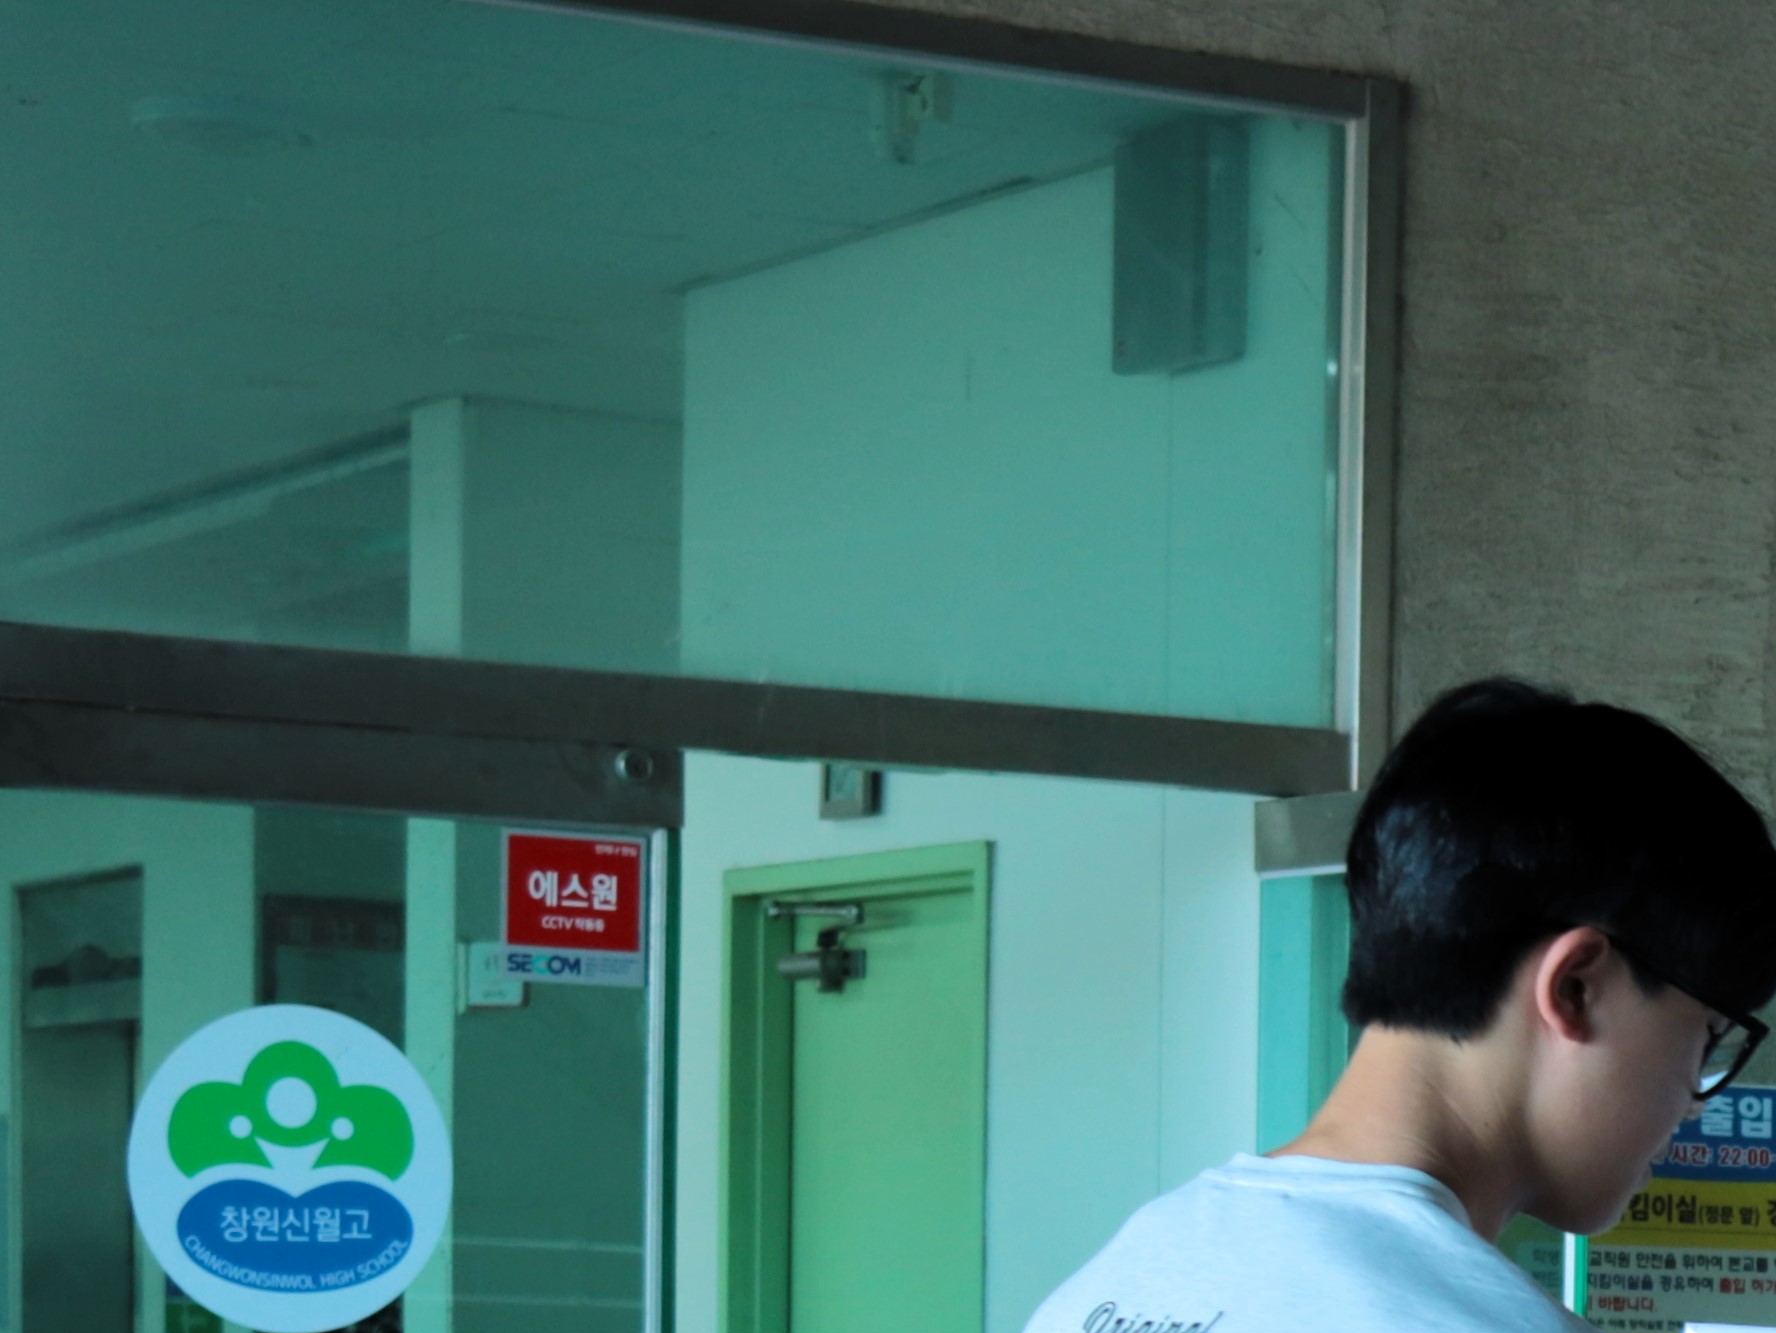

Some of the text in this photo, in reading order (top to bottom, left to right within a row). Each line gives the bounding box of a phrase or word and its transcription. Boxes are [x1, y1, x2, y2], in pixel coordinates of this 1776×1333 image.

[528, 869, 618, 911] 에스원
[541, 915, 574, 930] CCTV
[507, 953, 581, 975] SECOM
[220, 1205, 373, 1243] 창원신월고
[320, 1269, 355, 1288] HIGH
[357, 1238, 410, 1280] SCHOOL
